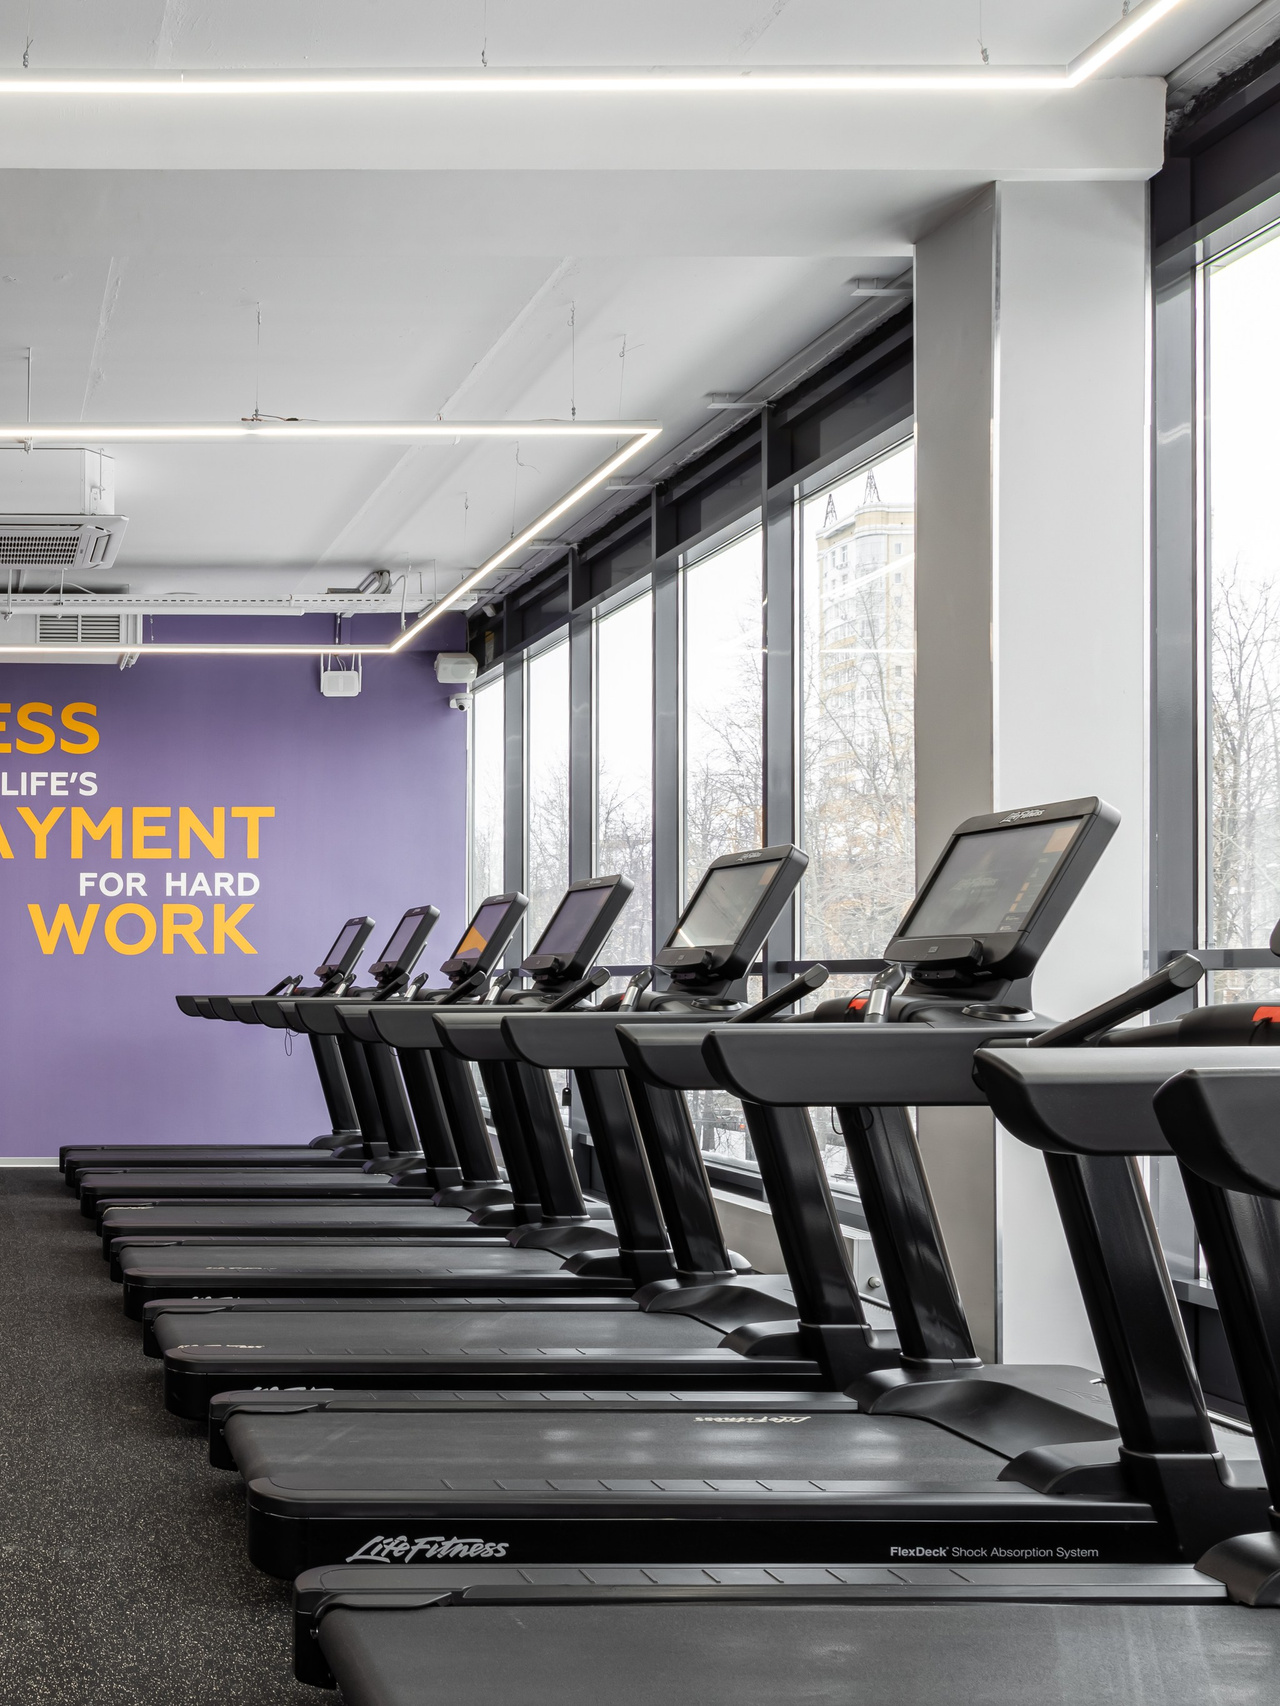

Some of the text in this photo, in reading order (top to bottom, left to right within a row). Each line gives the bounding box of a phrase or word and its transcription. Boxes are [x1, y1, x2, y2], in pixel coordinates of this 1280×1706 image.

[1, 772, 98, 796] LIFE'S
[79, 872, 260, 897] FOR HARD
[28, 903, 258, 956] WORK
[951, 1546, 988, 1557] Shock
[990, 1546, 1053, 1559] Absorption
[1056, 1546, 1099, 1559] System
